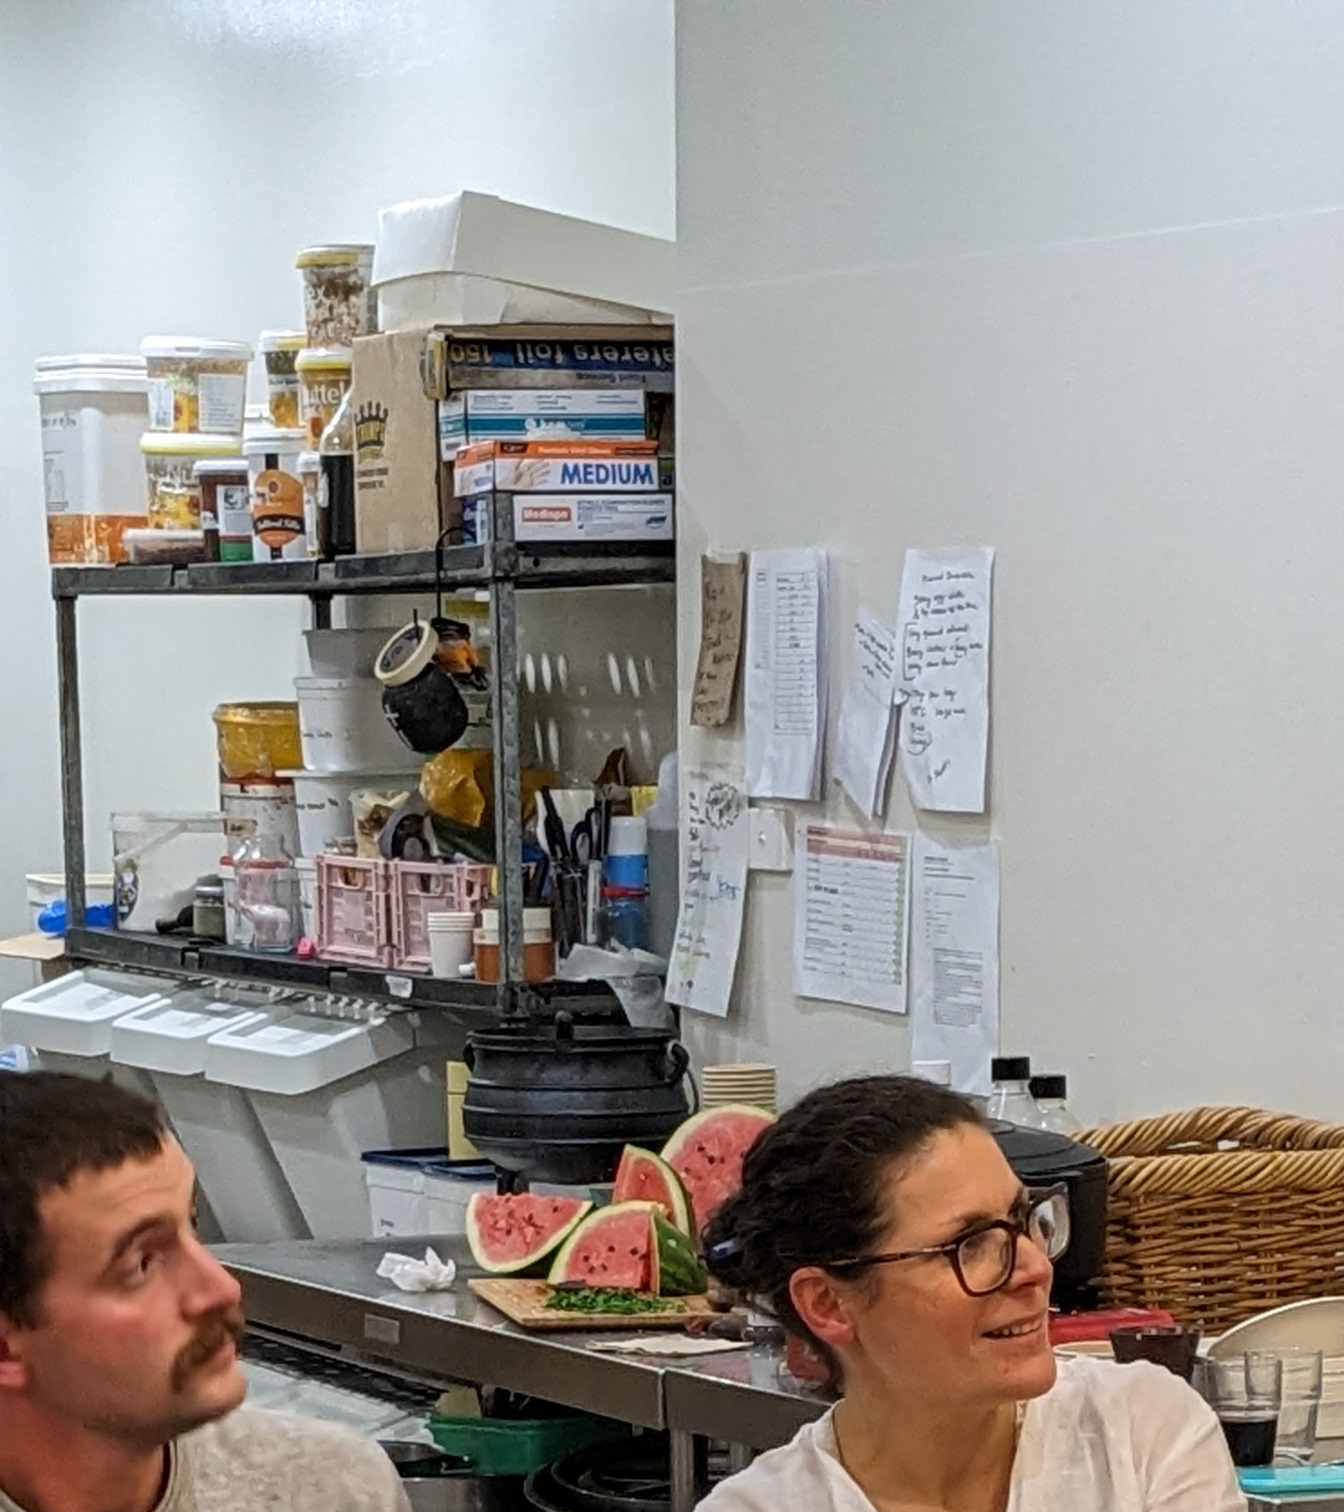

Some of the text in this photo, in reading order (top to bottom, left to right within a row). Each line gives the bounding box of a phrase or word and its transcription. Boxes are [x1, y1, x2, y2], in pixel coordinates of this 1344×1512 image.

[451, 343, 493, 364] 150
[516, 342, 564, 366] foil
[560, 462, 654, 486] MEDIUM
